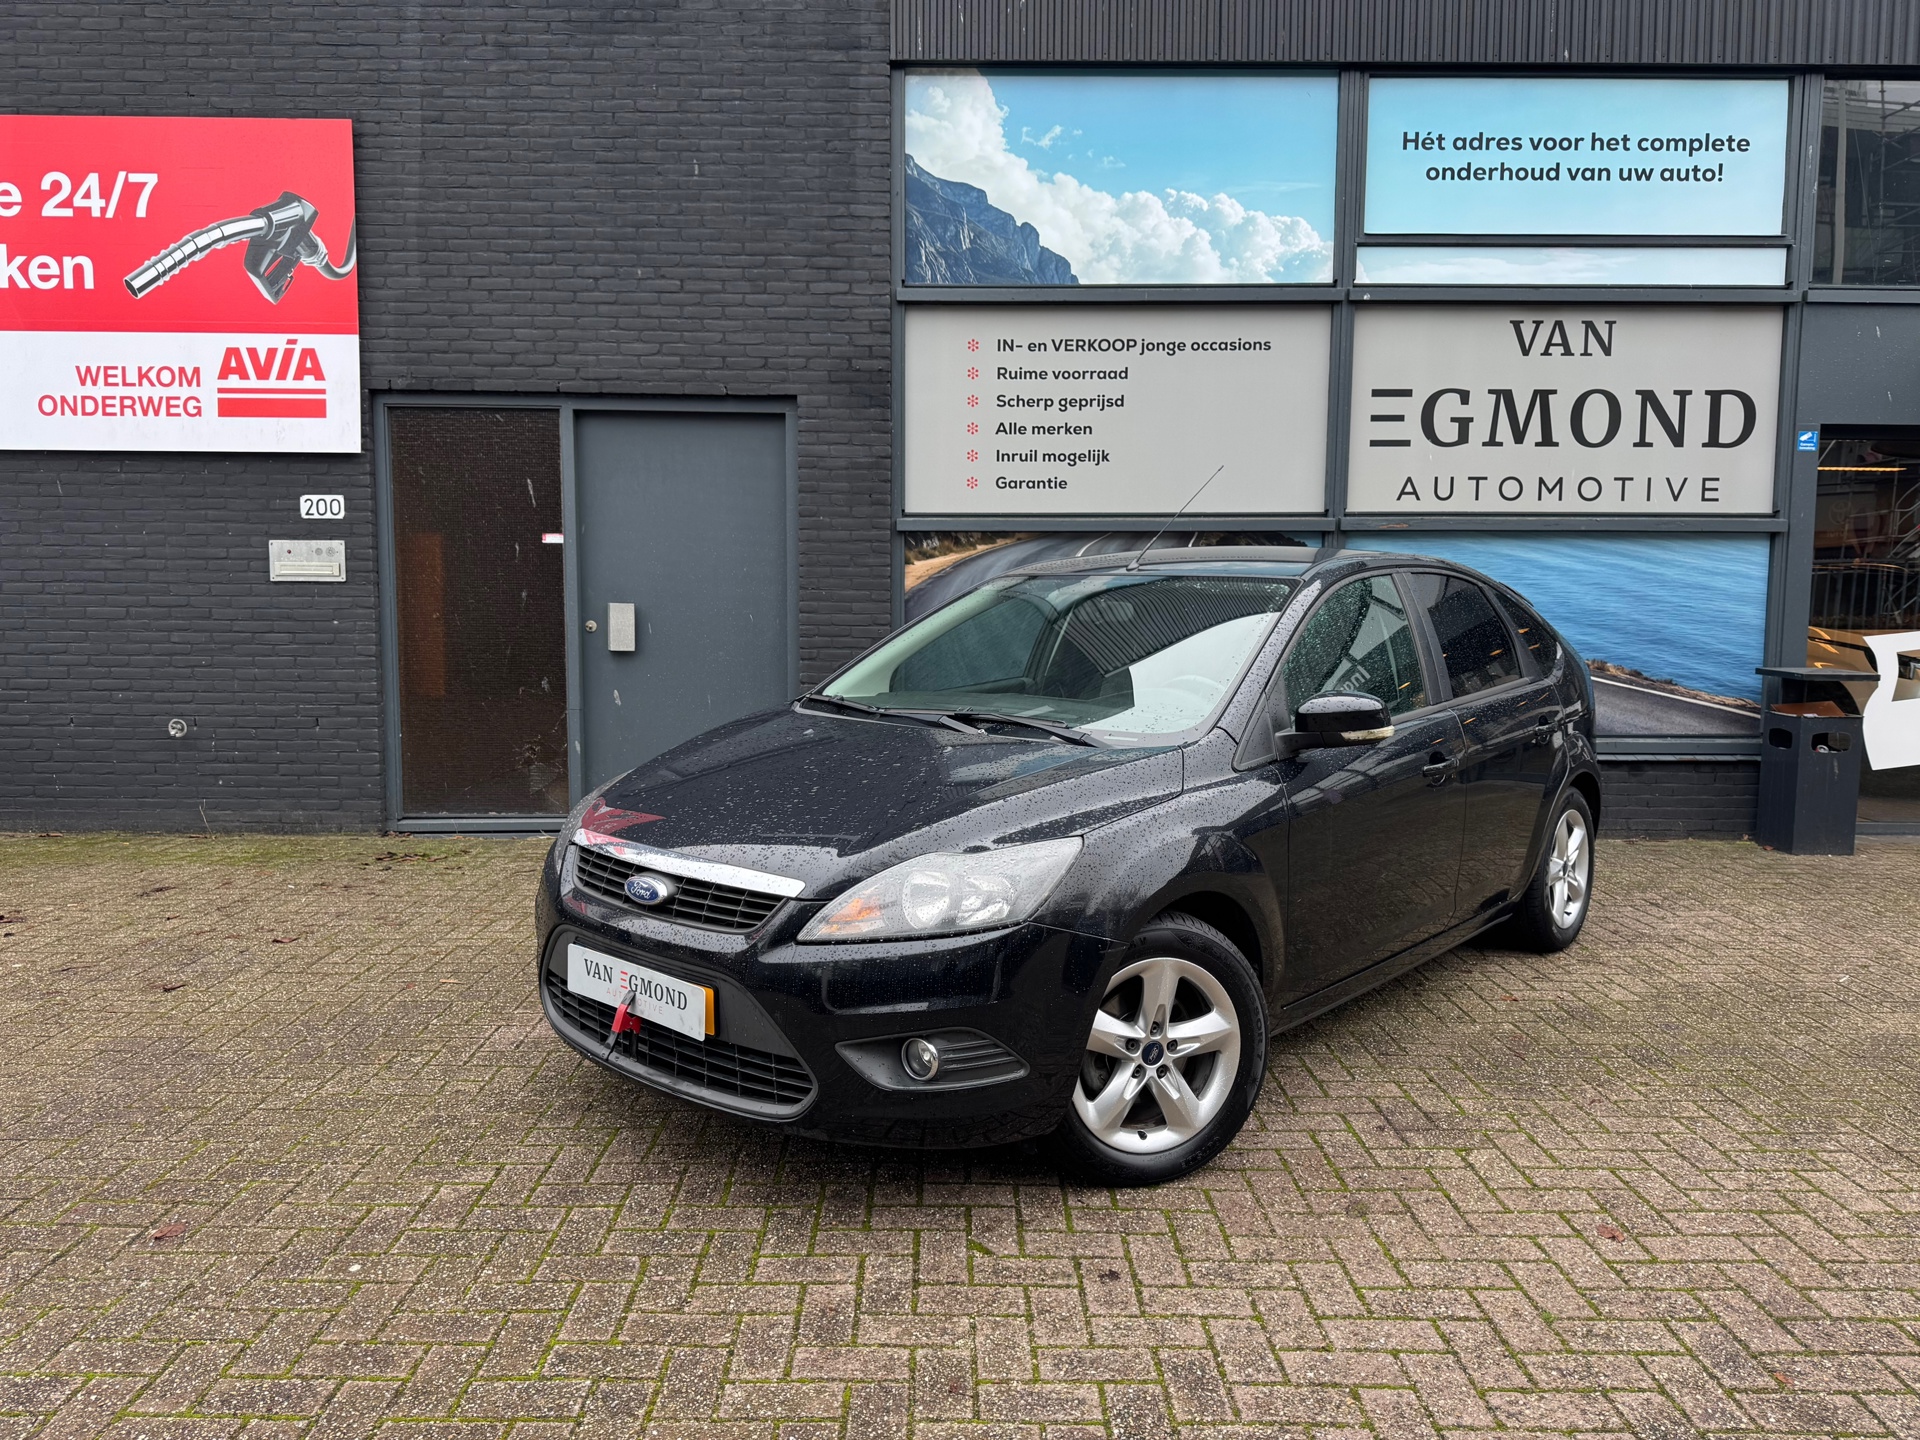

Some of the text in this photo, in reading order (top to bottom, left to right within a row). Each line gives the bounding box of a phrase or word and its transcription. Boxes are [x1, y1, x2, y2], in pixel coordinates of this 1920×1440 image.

[1402, 131, 1751, 157] Hét adres voor het complete
[1425, 161, 1724, 183] onderhoud van uw auto!
[40, 170, 159, 219] 24/7
[997, 338, 1272, 357] IN- en VERKOOP jonge occasions
[1509, 319, 1617, 357] VAN
[75, 365, 201, 388] WELKOM
[997, 366, 1129, 380] Ruime voorraad
[38, 395, 202, 418] ONDERWEG
[996, 394, 1125, 412] Scherp geprijsd
[995, 422, 1093, 436] Alle merken
[1369, 387, 1757, 449] EGMOND
[996, 449, 1110, 467] Inruil mogelijk
[995, 476, 1068, 490] Garantie
[1396, 476, 1720, 503] AUTOMOTIVE
[303, 498, 342, 516] 200
[630, 880, 653, 899] Ford
[583, 958, 614, 984] VAN
[606, 987, 663, 1015] AUTOTIVE
